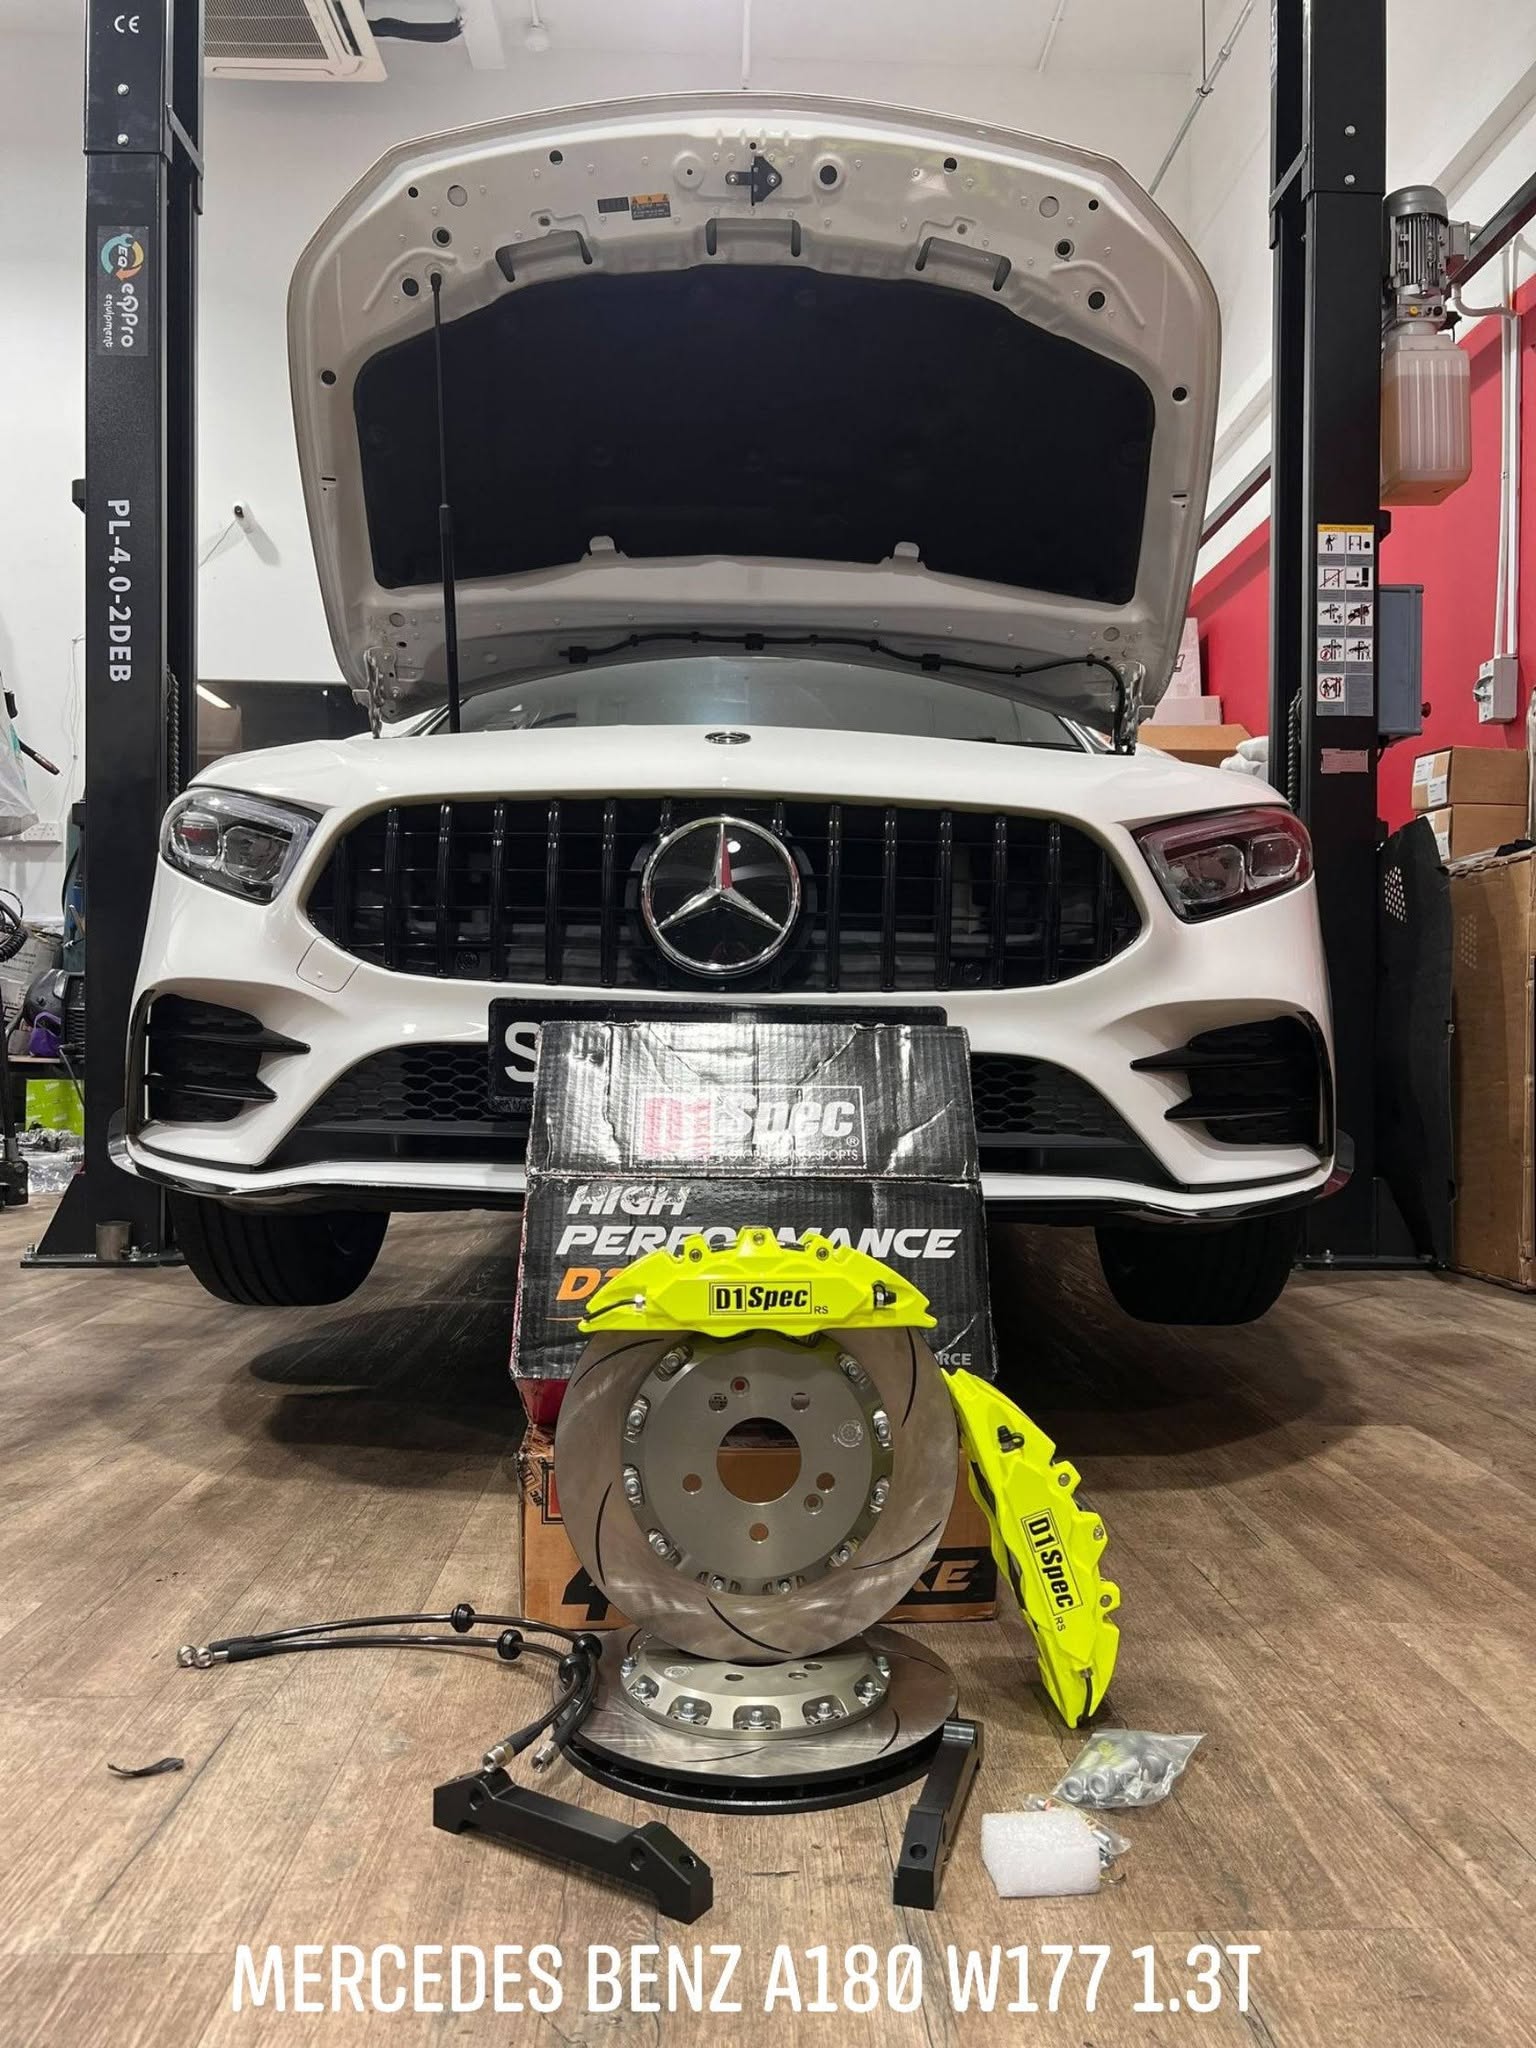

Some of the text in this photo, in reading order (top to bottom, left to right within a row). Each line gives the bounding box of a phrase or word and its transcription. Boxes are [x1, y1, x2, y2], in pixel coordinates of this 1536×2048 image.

[113, 14, 140, 34] CE
[102, 293, 115, 348] equipment
[107, 499, 132, 682] PL-4.0-2DEB
[566, 1184, 691, 1216] HIGH
[813, 1305, 829, 1315] RS
[934, 1352, 973, 1367] RCE
[1054, 1615, 1066, 1633] RS
